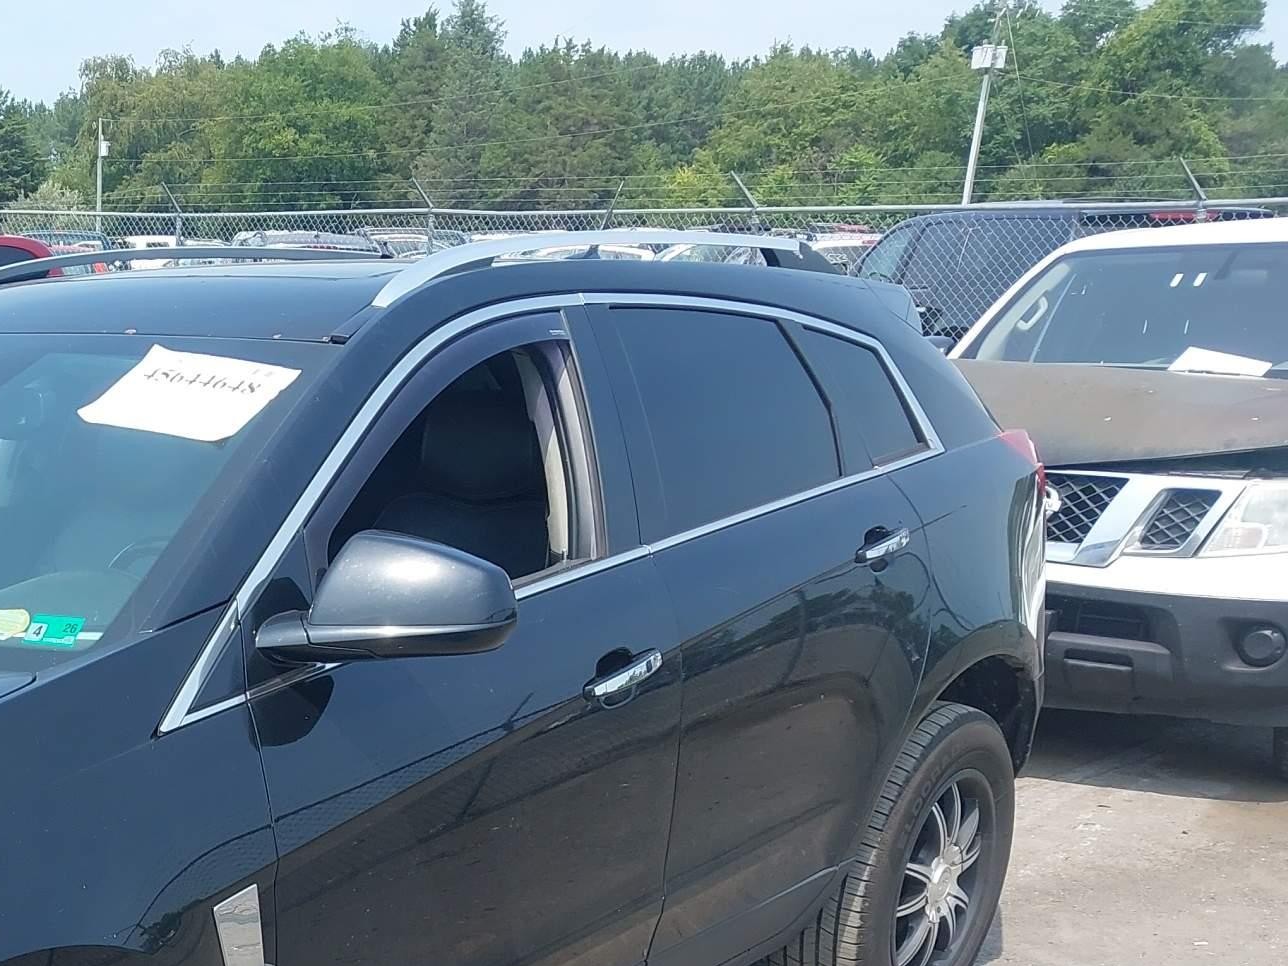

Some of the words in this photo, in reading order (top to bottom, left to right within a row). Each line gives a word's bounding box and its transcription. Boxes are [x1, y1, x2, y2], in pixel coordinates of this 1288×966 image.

[143, 367, 261, 393] 45644648
[33, 625, 43, 637] 4
[62, 623, 78, 634] 26
